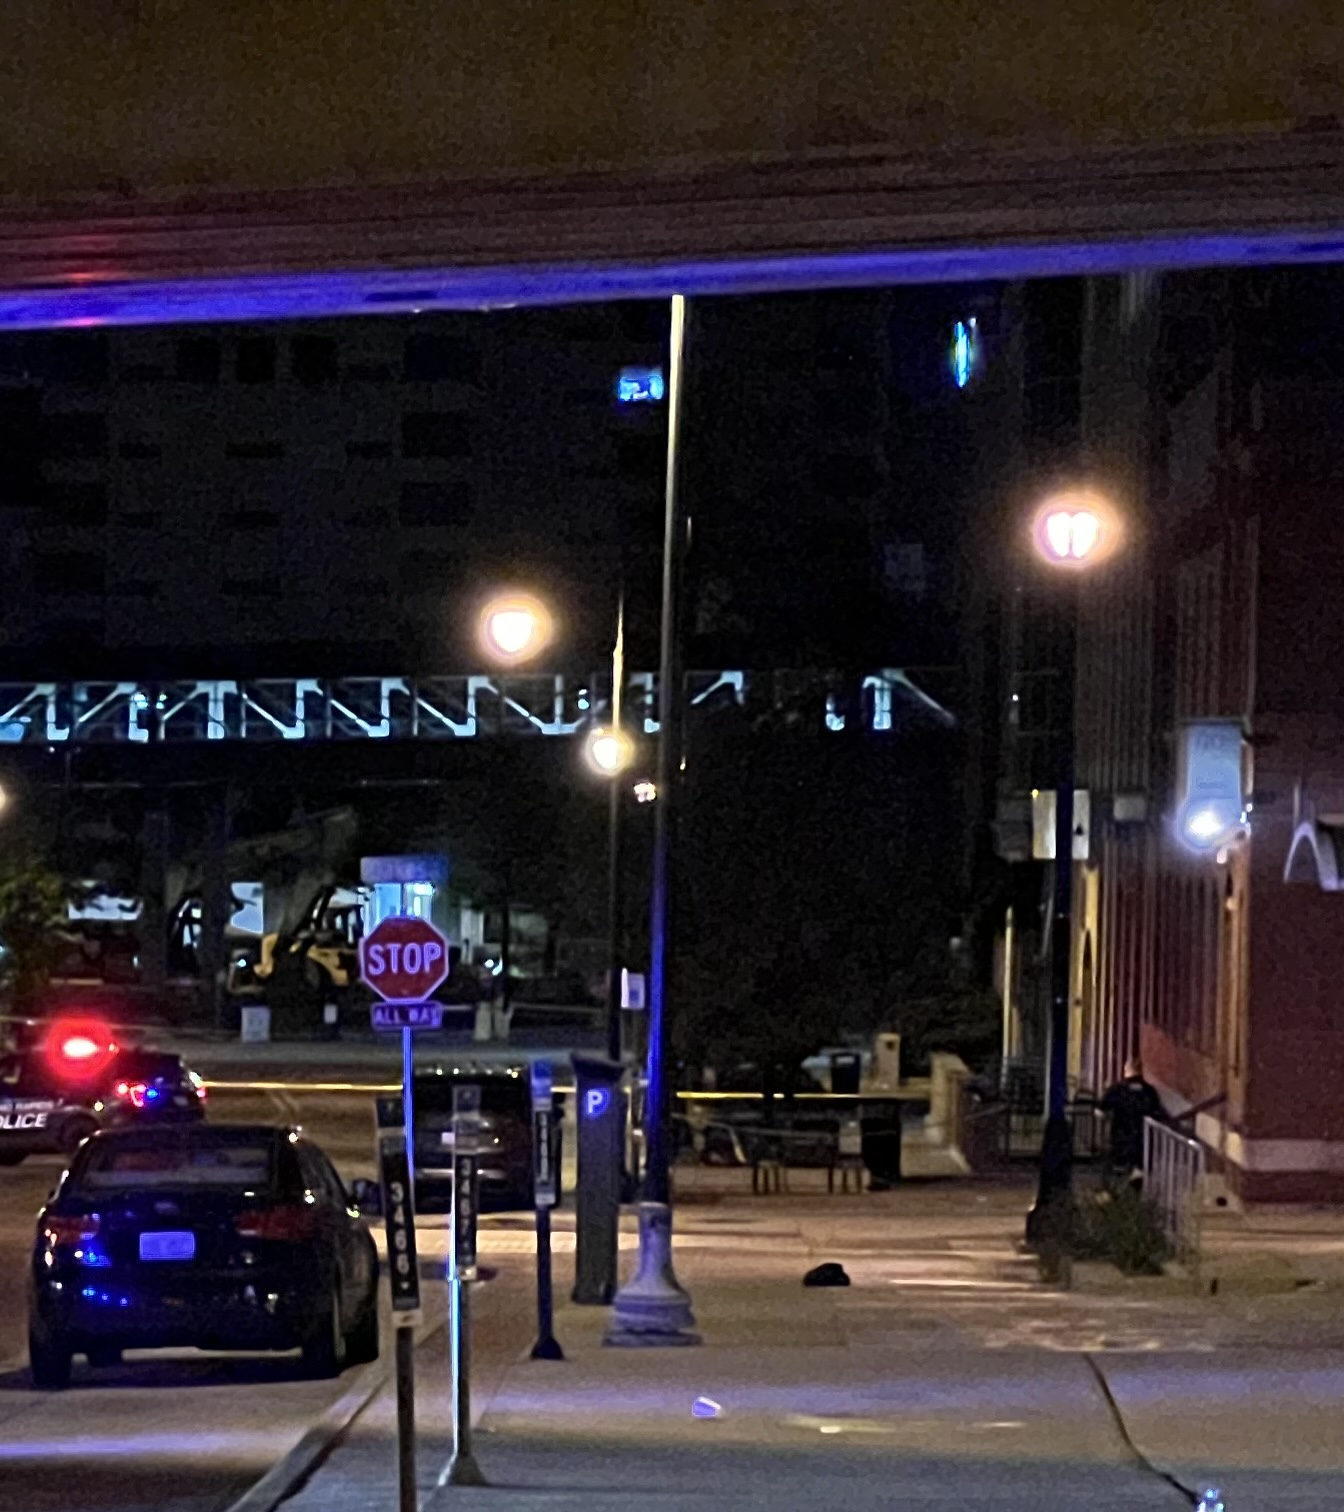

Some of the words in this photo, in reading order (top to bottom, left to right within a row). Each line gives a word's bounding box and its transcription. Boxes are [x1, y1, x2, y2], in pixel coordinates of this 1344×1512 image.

[368, 942, 441, 975] STOP
[588, 1089, 603, 1113] P
[390, 1182, 410, 1276] 3466
